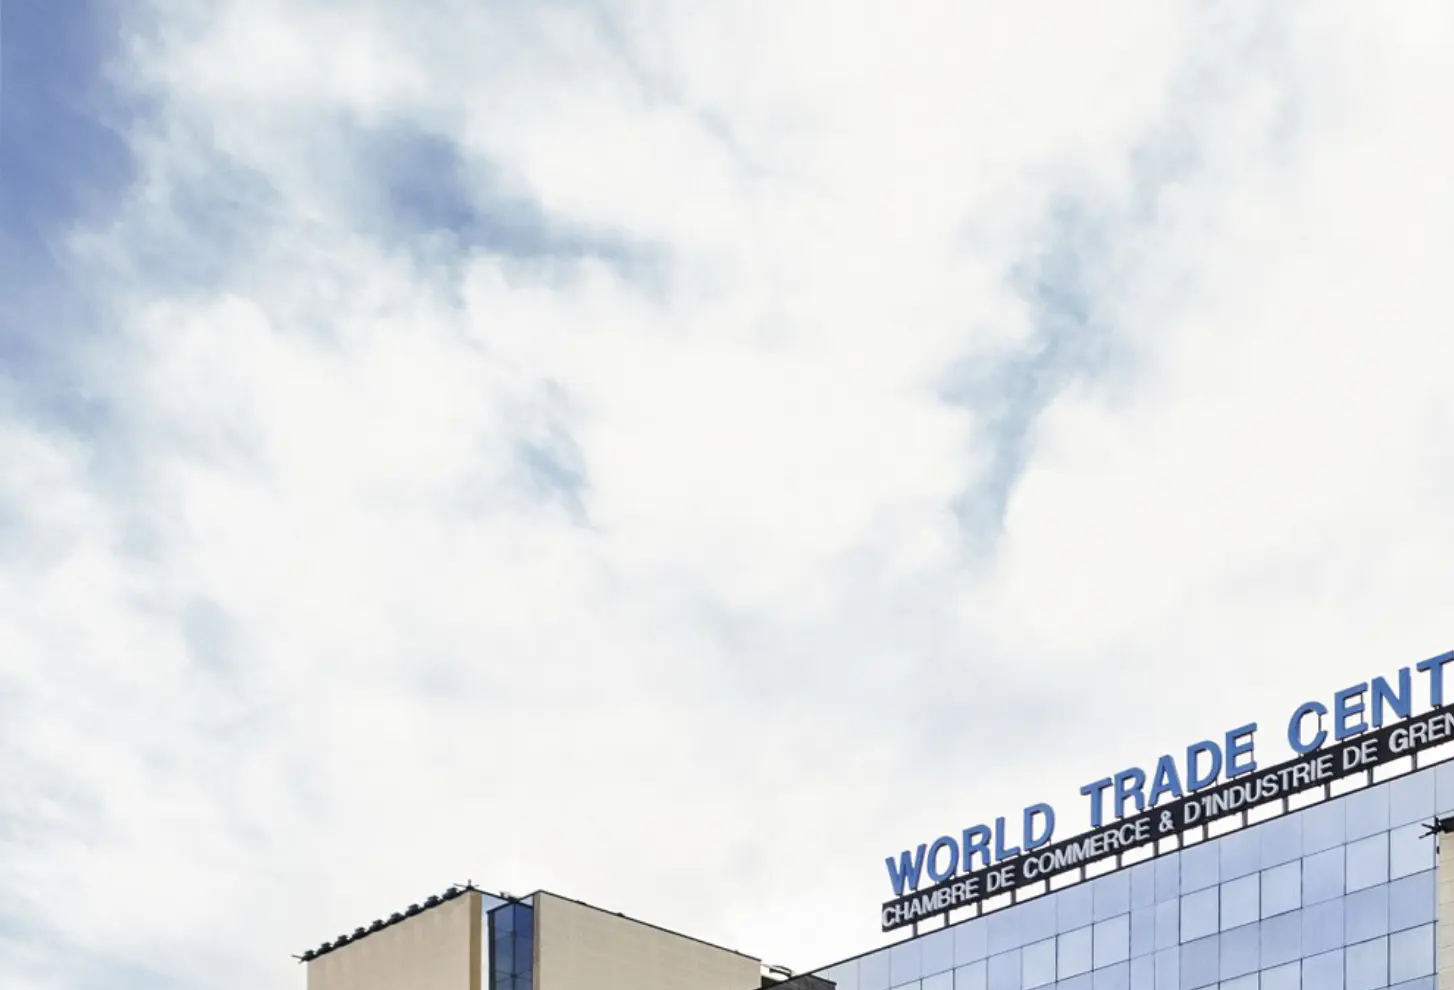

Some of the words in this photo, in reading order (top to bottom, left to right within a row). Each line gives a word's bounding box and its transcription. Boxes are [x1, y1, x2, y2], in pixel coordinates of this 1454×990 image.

[882, 878, 980, 928] CHAMBRE
[986, 866, 1016, 892] DE
[1022, 816, 1150, 880] COMMERCE
[1158, 810, 1174, 833] &
[1183, 754, 1334, 825] D'INDUSTRIE
[1342, 739, 1379, 772] DE
[885, 802, 1056, 896] WORLD
[1080, 722, 1258, 828] TRADE
